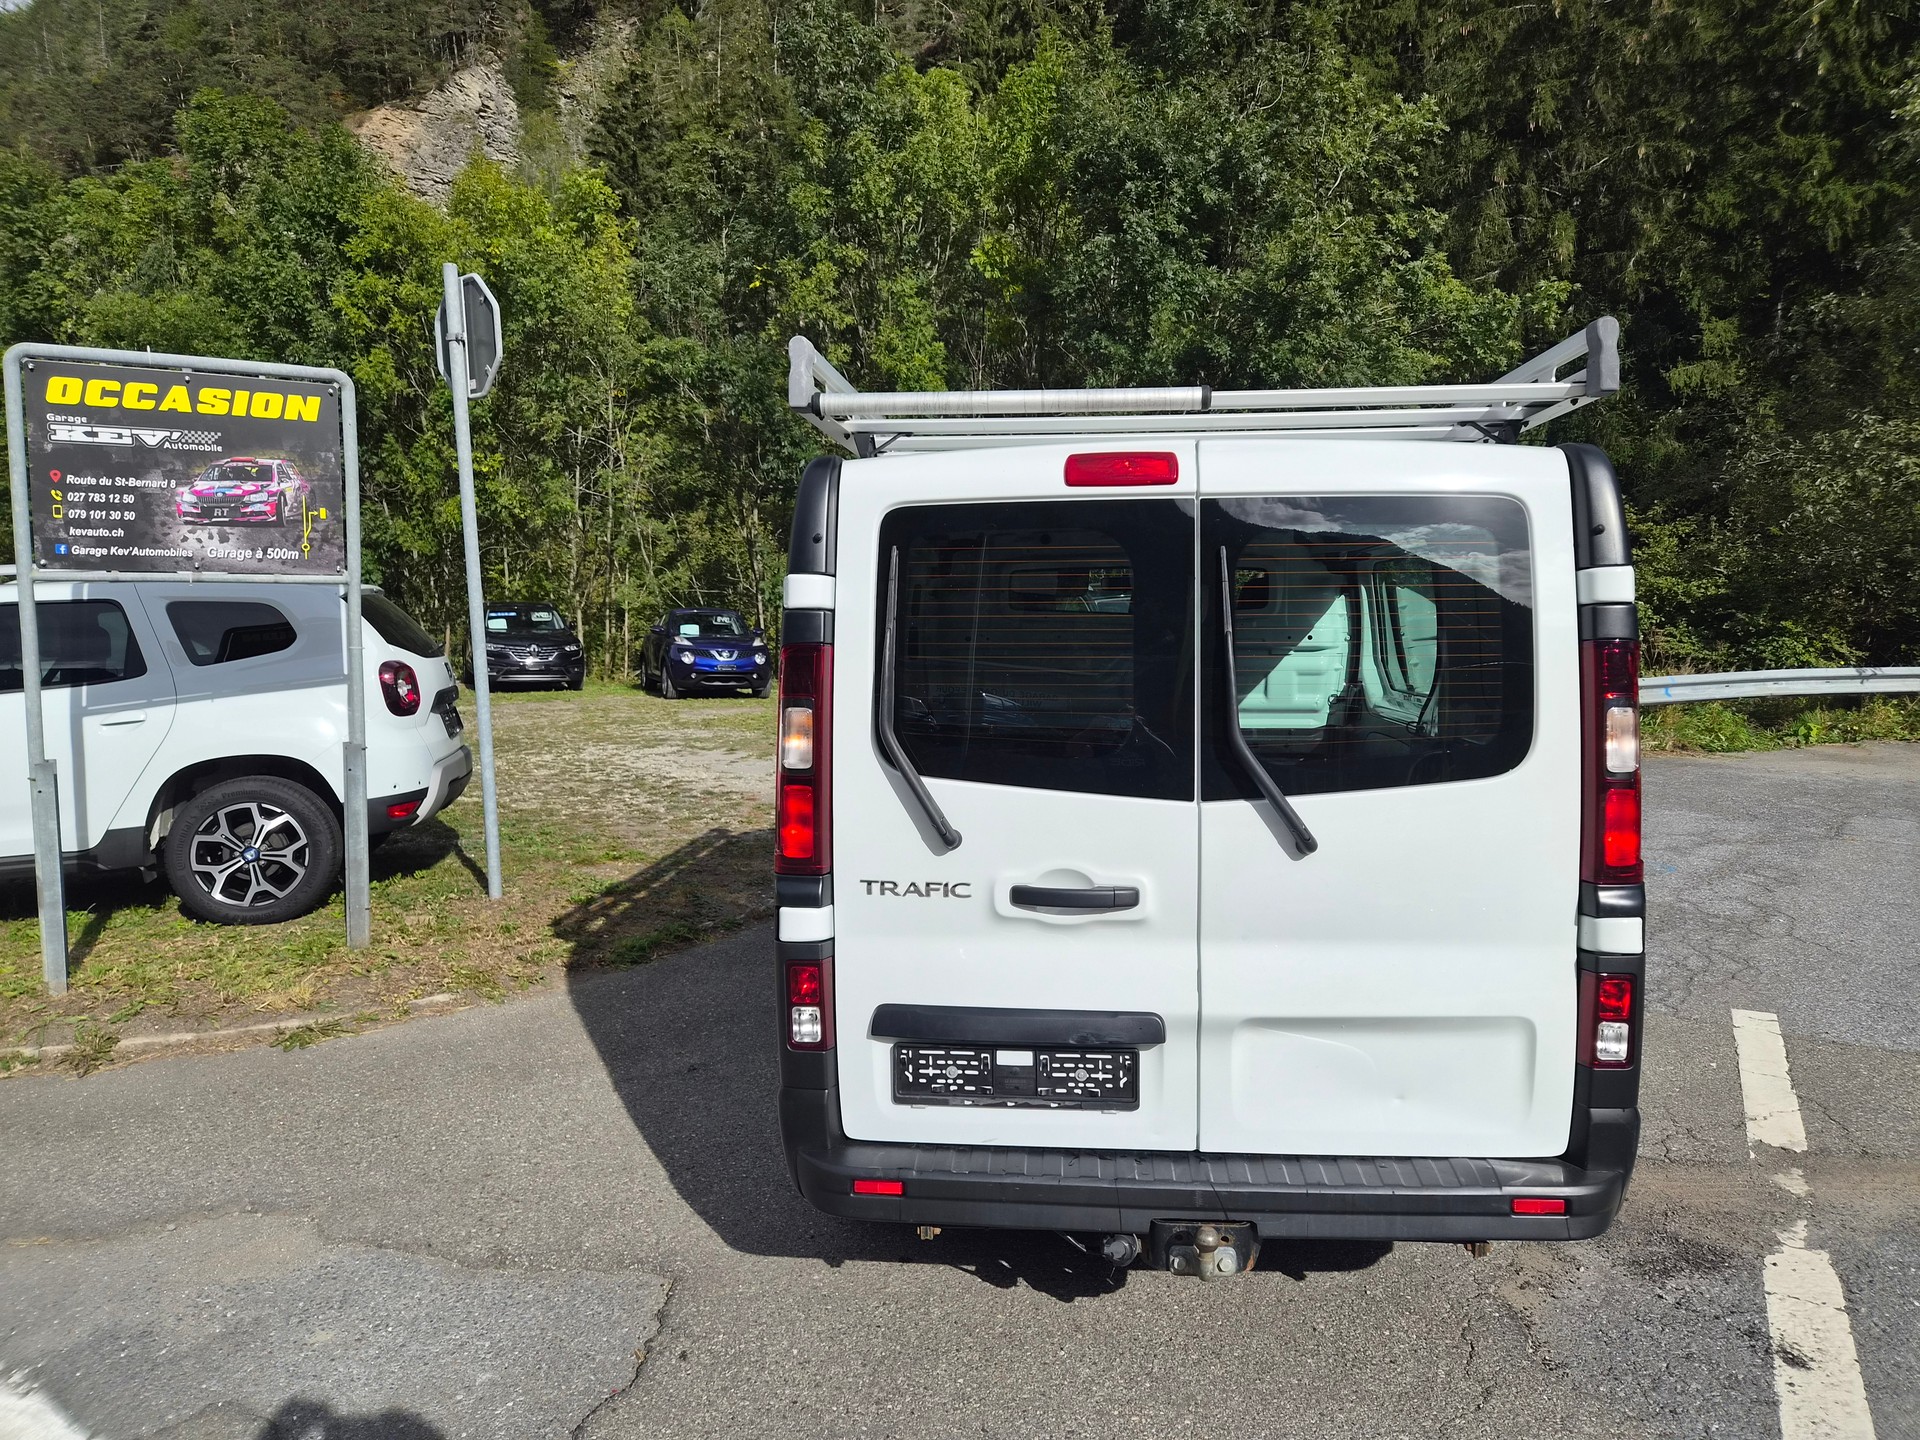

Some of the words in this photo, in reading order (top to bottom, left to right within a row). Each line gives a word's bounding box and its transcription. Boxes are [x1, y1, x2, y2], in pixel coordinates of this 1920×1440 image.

[45, 376, 321, 422] OCCASION
[46, 413, 88, 424] Garage
[163, 441, 223, 452] Automobile
[66, 474, 97, 486] Route
[99, 476, 112, 486] du
[115, 477, 168, 489] St-Bernard
[170, 479, 176, 489] 8
[67, 493, 86, 502] 027
[88, 493, 107, 503] 783
[109, 493, 120, 503] 12
[122, 494, 135, 504] 50
[68, 509, 87, 519] 079
[89, 510, 107, 520] 101
[109, 510, 121, 520] 30
[123, 511, 135, 521] 50
[69, 527, 124, 538] kevauto.ch
[71, 545, 108, 557] Garage
[207, 547, 252, 560] Garage
[256, 547, 263, 559] à
[266, 548, 299, 560] 500m
[860, 879, 972, 899] TRAFIC
